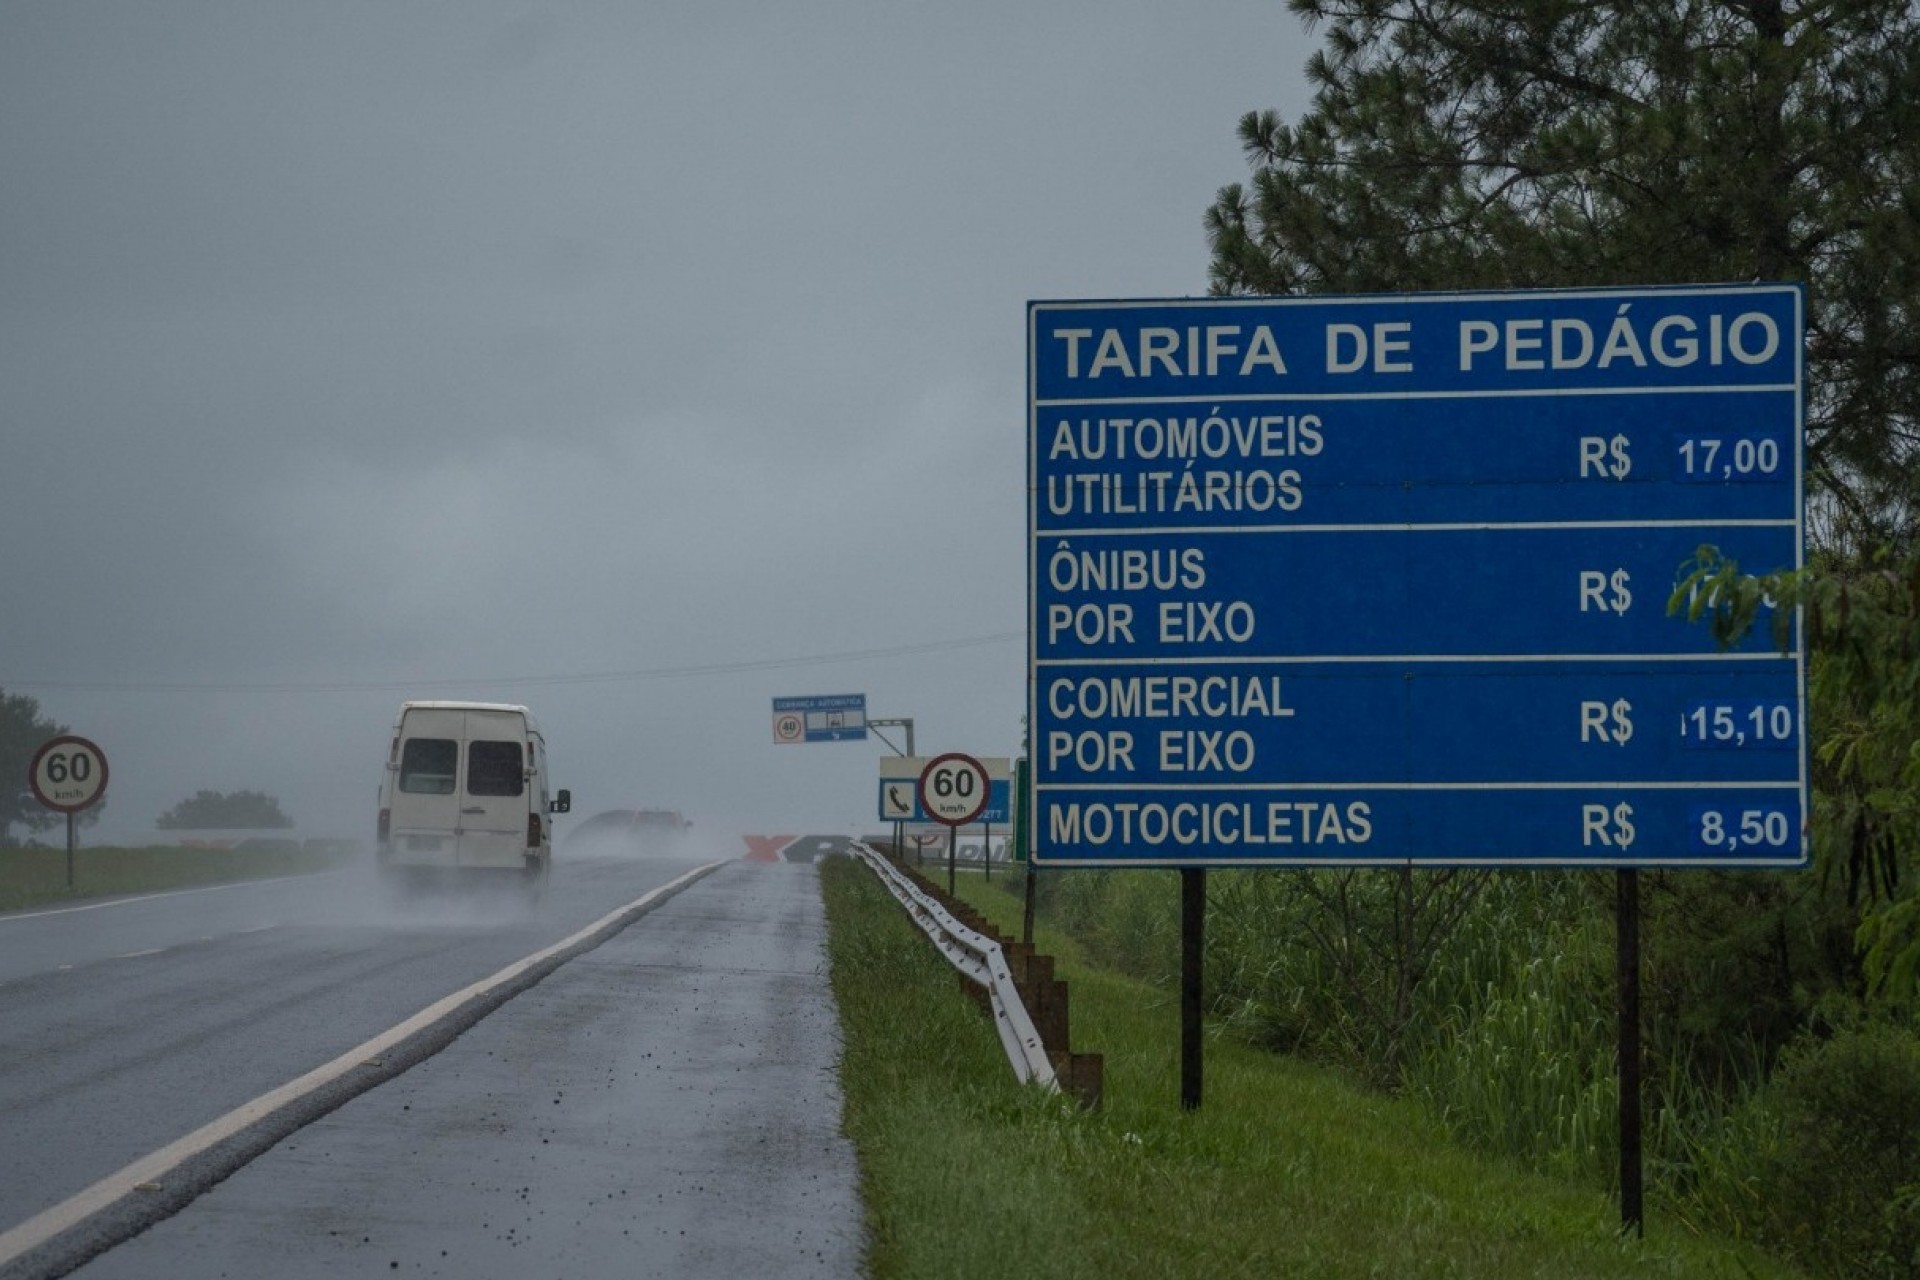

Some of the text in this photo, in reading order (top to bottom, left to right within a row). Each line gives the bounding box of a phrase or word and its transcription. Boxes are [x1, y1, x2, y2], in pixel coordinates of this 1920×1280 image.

[1053, 303, 1780, 379] TARIFA DE PEDÁGIO
[1049, 406, 1324, 460] AUTOMÓVEIS
[1579, 432, 1779, 481] R$ 17,00
[1048, 460, 1303, 516] UTILITÁRIOS
[1049, 540, 1206, 592] ÔNIBUS
[1580, 567, 1633, 617] R$
[1048, 600, 1256, 645] POR EIXO
[1048, 676, 1295, 720] COMERCIAL
[1580, 697, 1792, 747] R$ 15,10
[782, 720, 796, 730] 40
[47, 752, 90, 783] 60
[1048, 730, 1255, 773] POR EIXO
[934, 768, 974, 797] 60
[939, 803, 967, 813] km/h
[1050, 801, 1789, 851] MOTOCICLETAS R$ 8,50
